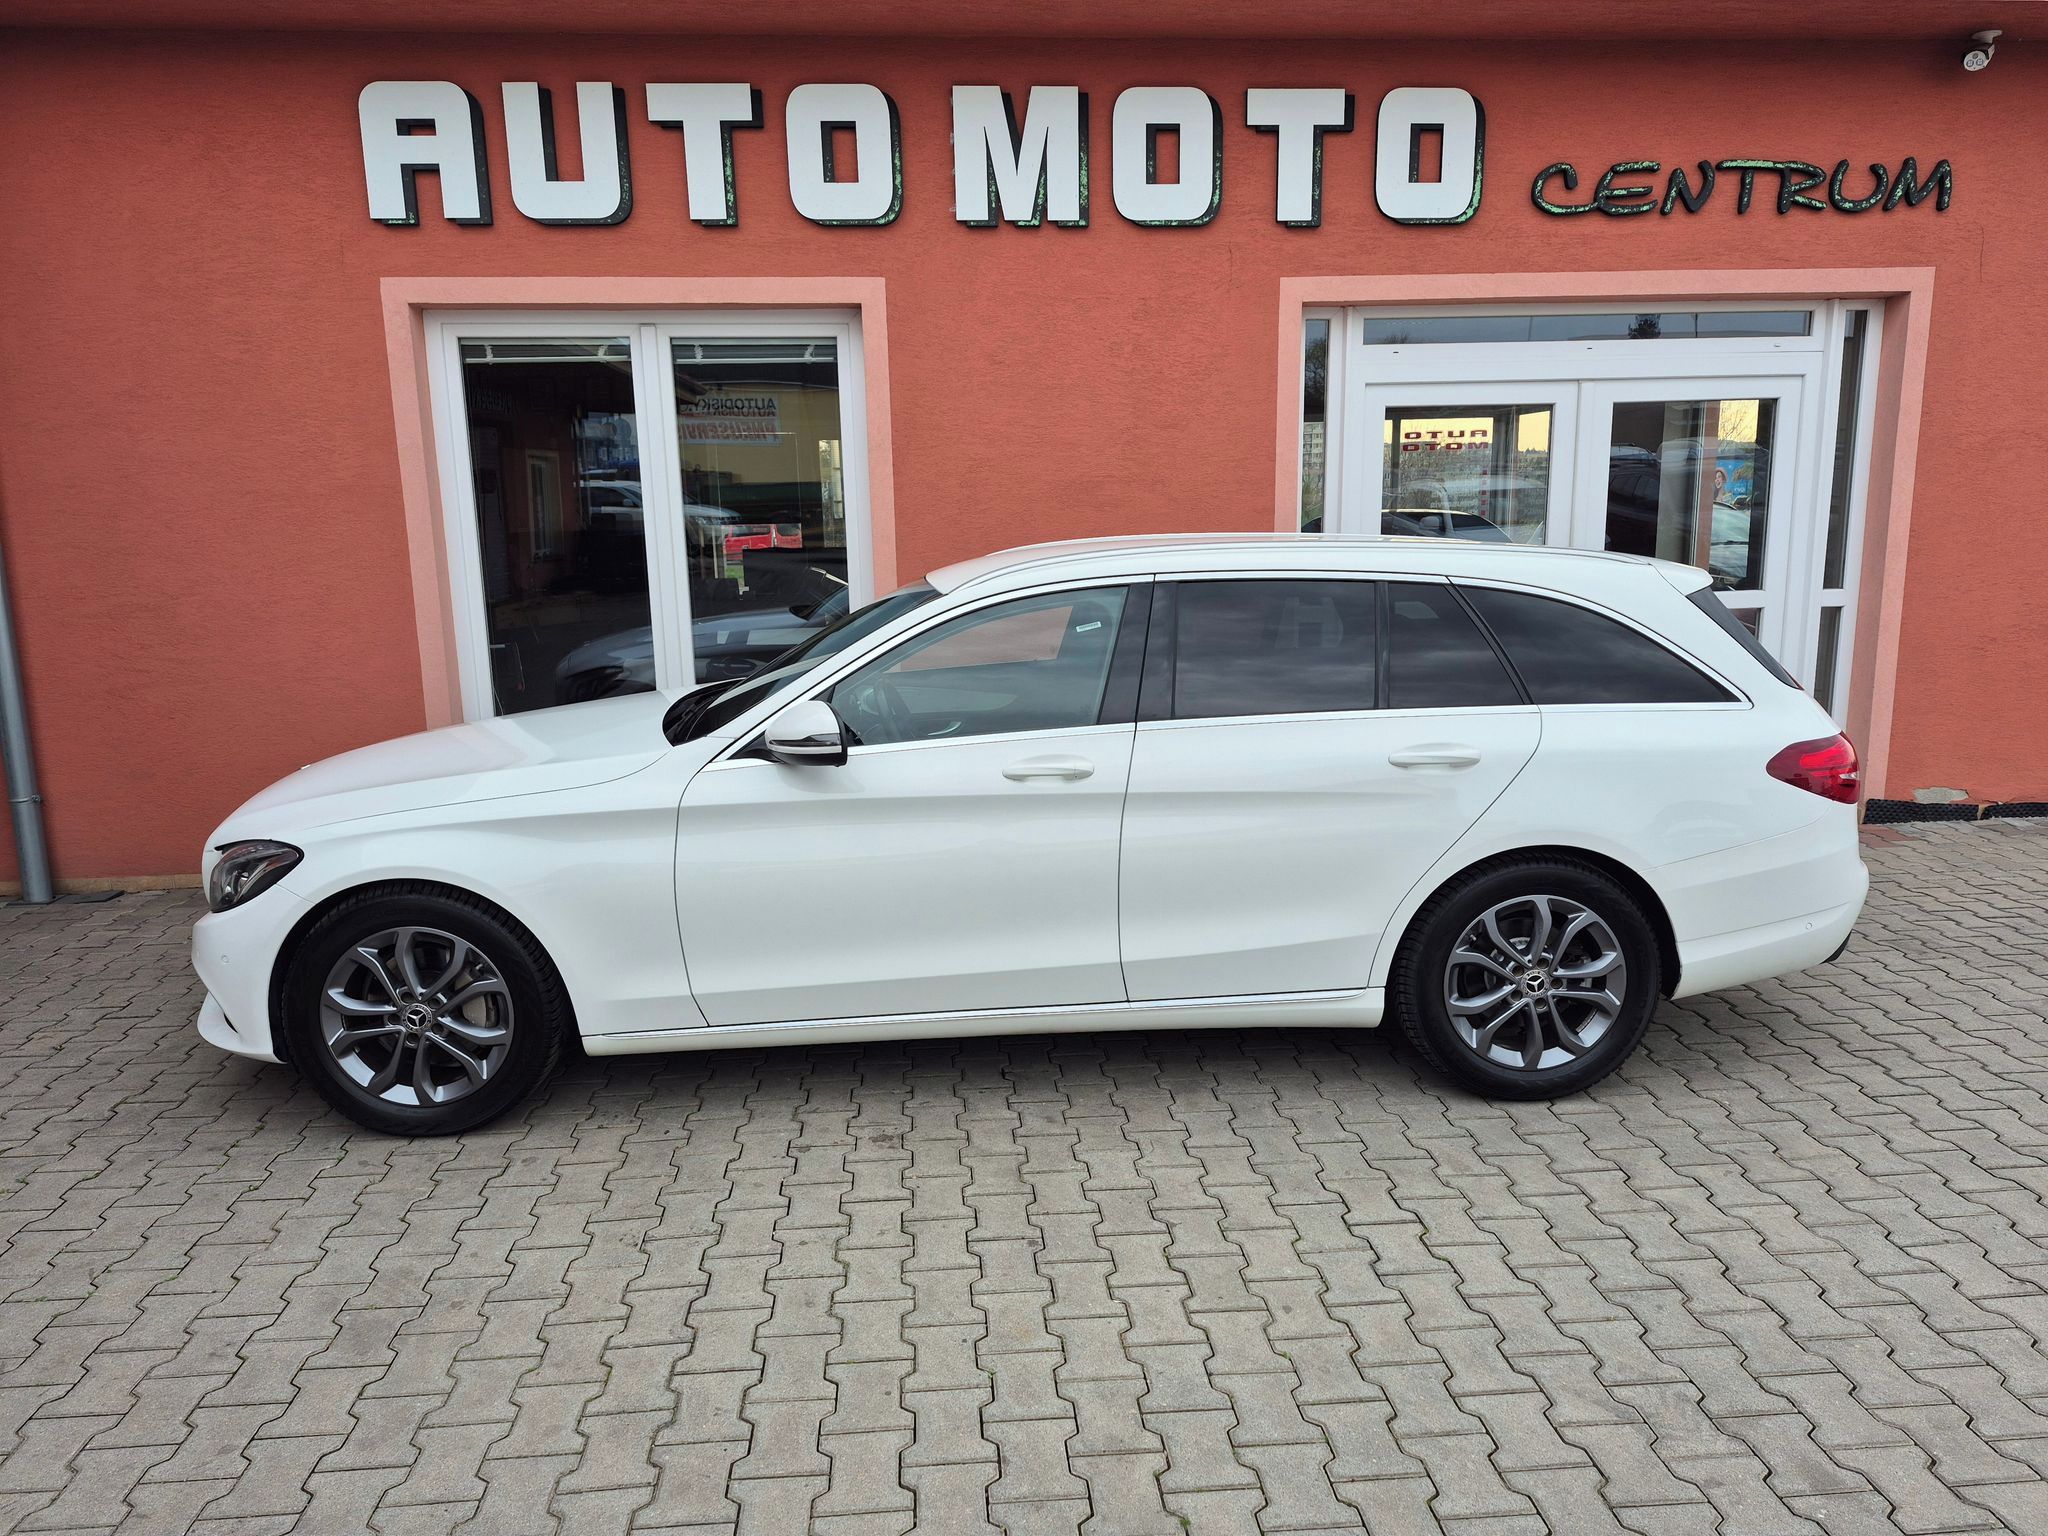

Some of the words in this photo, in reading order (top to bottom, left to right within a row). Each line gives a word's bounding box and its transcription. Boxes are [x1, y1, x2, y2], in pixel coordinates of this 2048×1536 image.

[358, 80, 903, 226] AUTO
[951, 85, 1486, 227] MOTO
[1531, 156, 1953, 217] CENTRUM
